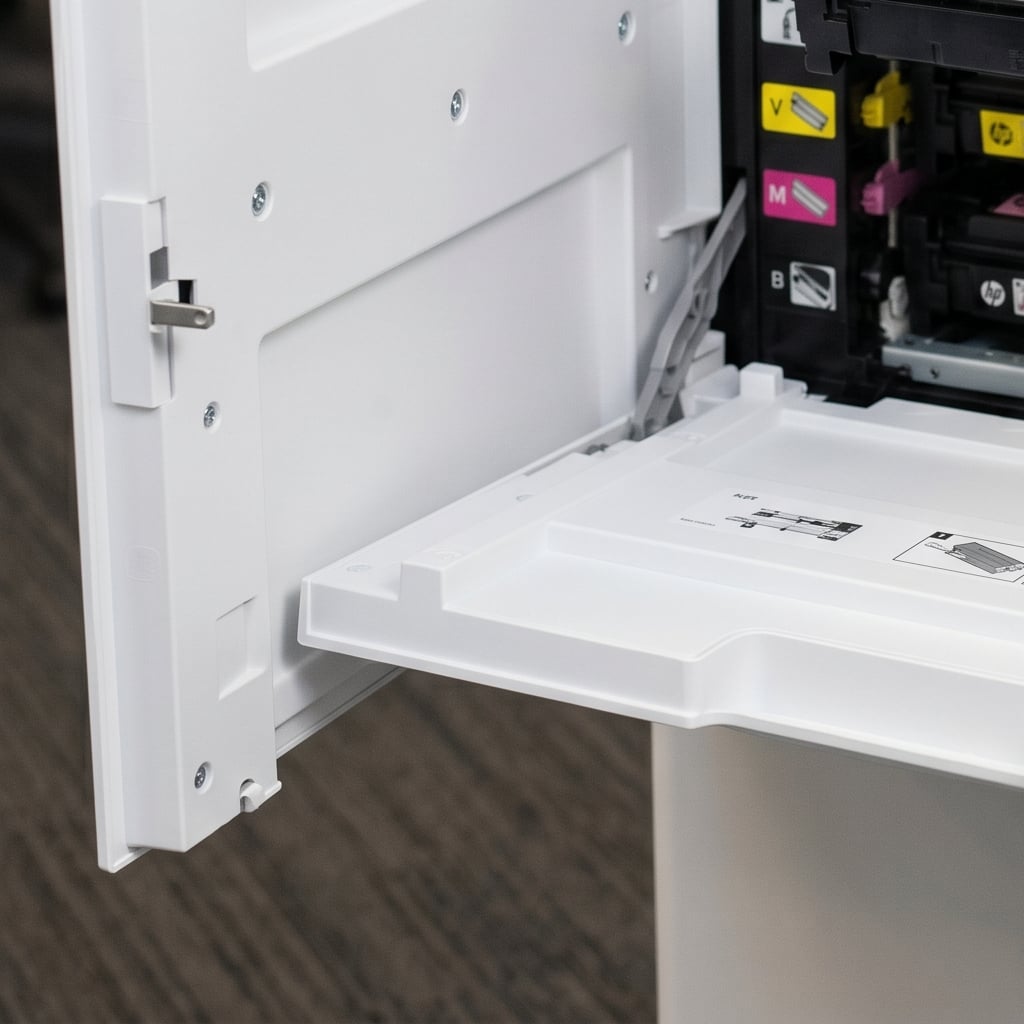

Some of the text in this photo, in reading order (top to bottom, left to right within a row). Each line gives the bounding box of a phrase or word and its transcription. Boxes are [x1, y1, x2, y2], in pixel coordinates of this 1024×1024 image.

[769, 97, 783, 116] V
[768, 183, 787, 206] M
[771, 269, 785, 289] B
[982, 280, 1004, 306] hp
